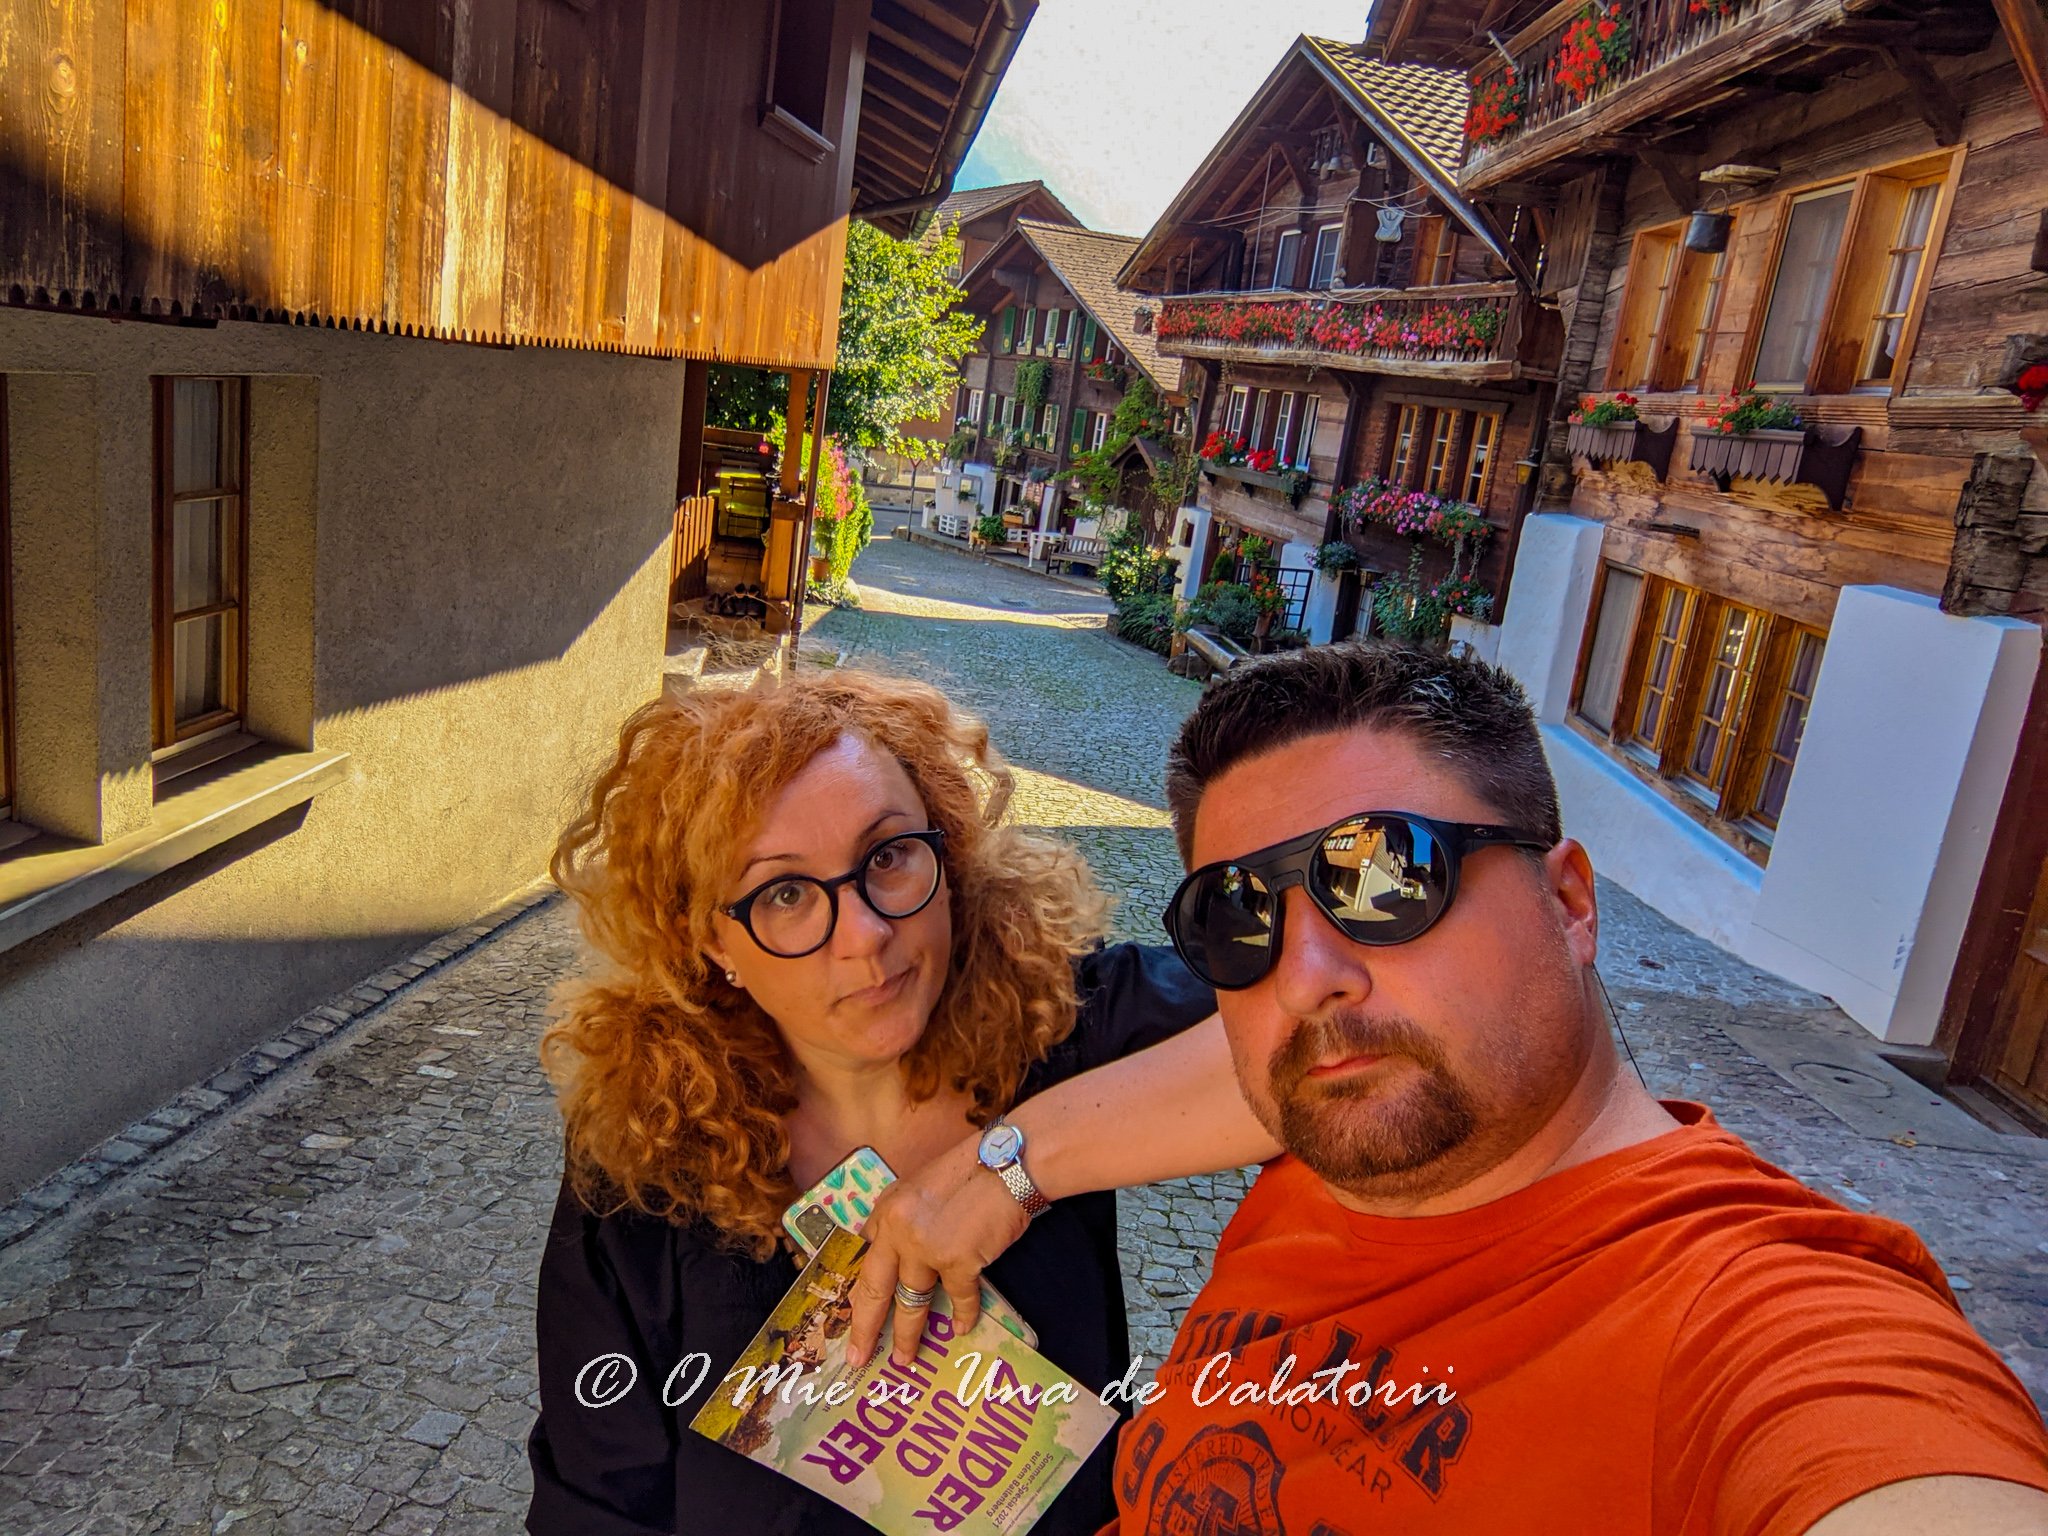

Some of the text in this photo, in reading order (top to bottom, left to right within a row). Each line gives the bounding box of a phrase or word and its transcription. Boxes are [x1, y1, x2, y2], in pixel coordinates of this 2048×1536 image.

[896, 1389, 968, 1477] UND
[913, 1358, 1043, 1533] ZUNDER
[986, 1450, 1041, 1517] auf dem Ballenberg
[992, 1509, 1008, 1529] 2021
[1006, 1452, 1054, 1511] Sommer-Special
[1150, 1436, 1243, 1535] EGISTERED
